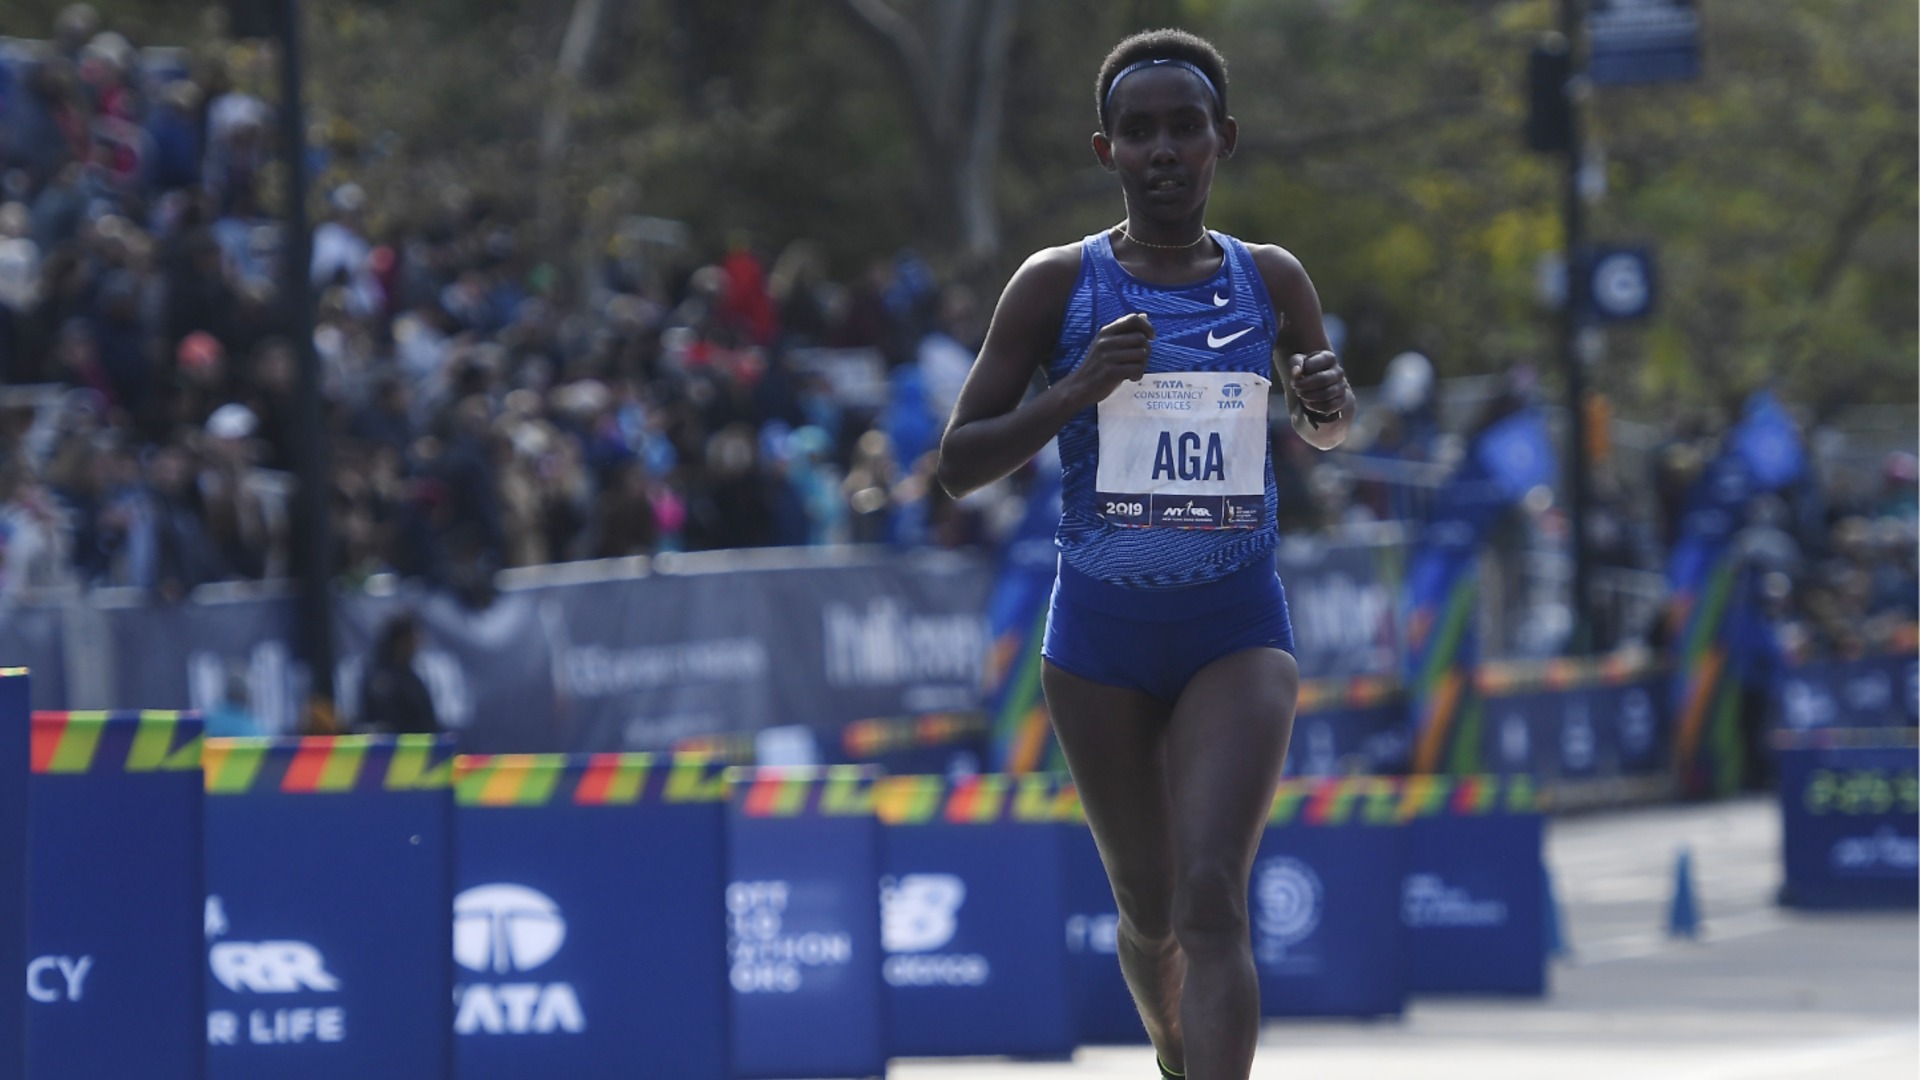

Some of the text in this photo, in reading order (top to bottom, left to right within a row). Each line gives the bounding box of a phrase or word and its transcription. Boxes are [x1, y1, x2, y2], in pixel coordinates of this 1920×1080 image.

[1154, 380, 1184, 389] TATA
[1134, 390, 1203, 400] CONSULTANCY
[1146, 401, 1191, 411] SERVICES
[1217, 400, 1245, 409] TATA
[1151, 431, 1225, 481] AGA
[1106, 501, 1143, 516] 2019
[27, 955, 93, 1002] CY
[453, 983, 586, 1034] ATA
[249, 1007, 345, 1043] LIFE
